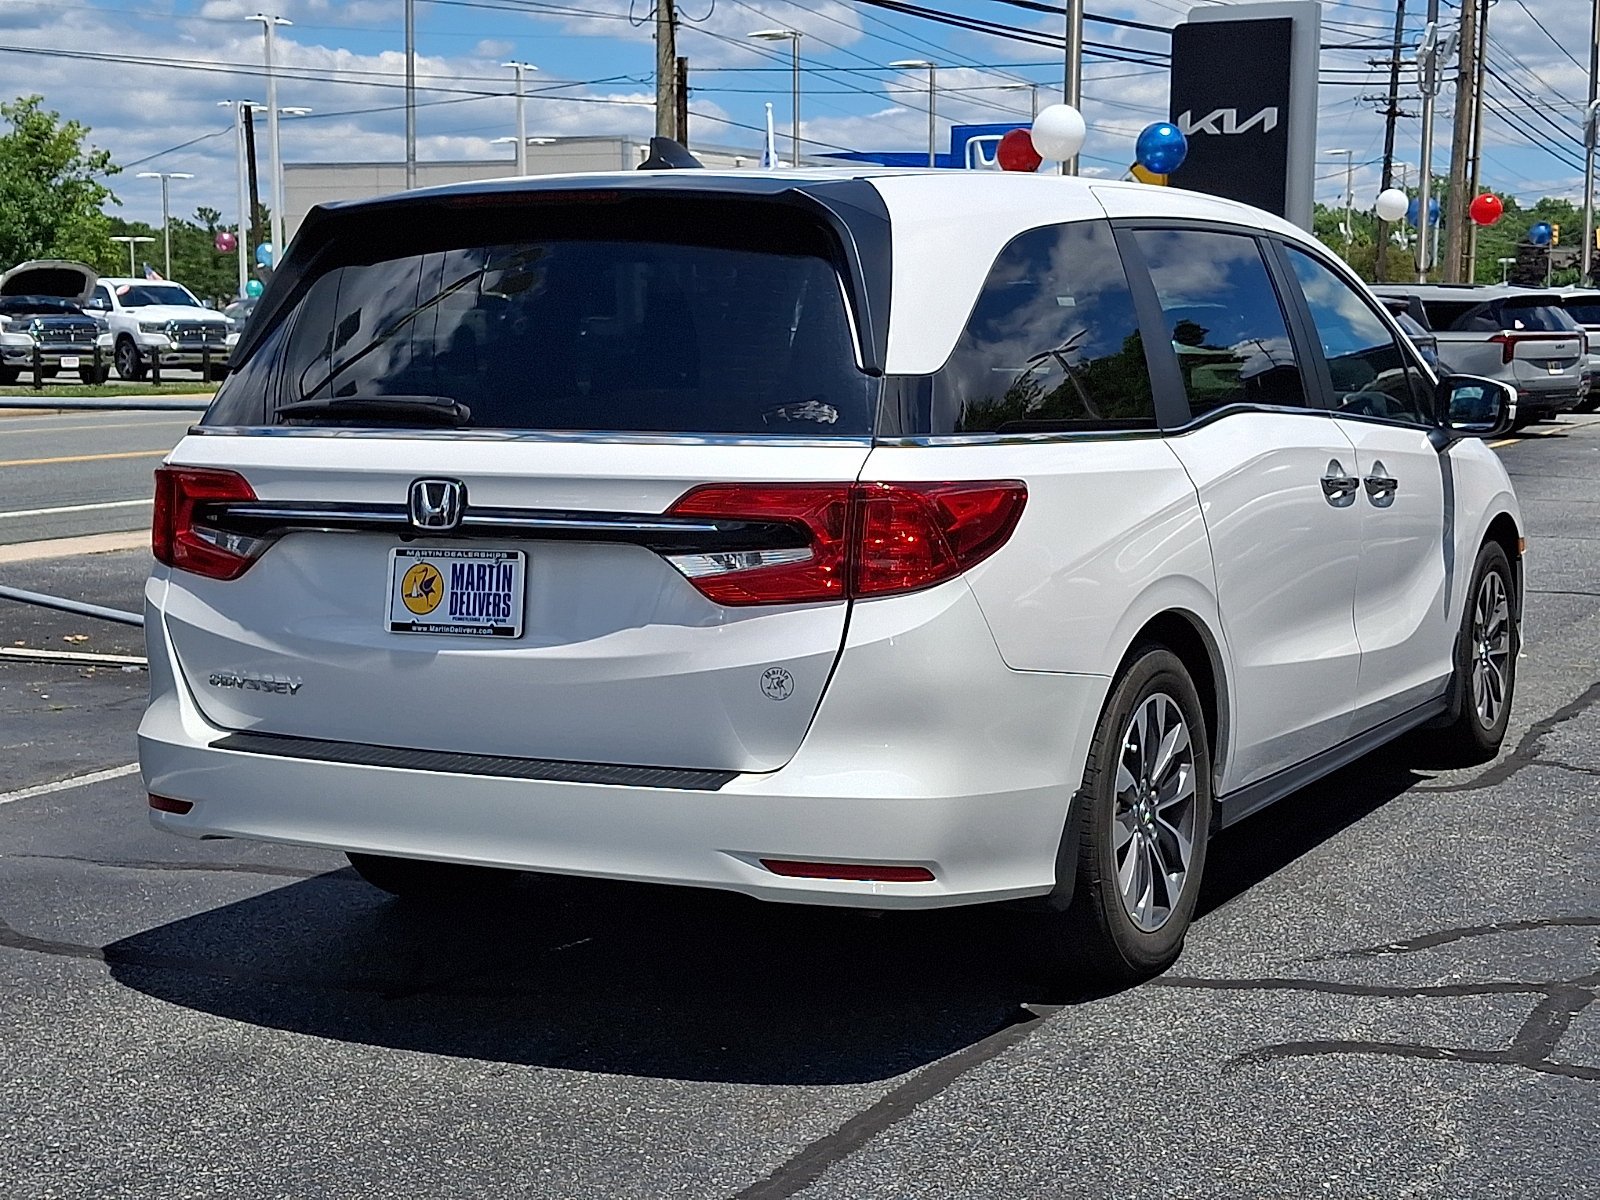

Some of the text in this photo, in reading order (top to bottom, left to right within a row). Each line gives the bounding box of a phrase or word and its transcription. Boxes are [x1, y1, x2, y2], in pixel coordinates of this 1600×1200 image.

[406, 549, 508, 559] MARTIN DEALERSHIPS
[451, 563, 512, 592] MARTIN
[449, 592, 511, 617] DELIVERS
[411, 624, 494, 635] www.MartinDelivers.com
[208, 671, 304, 695] ODYSSEY
